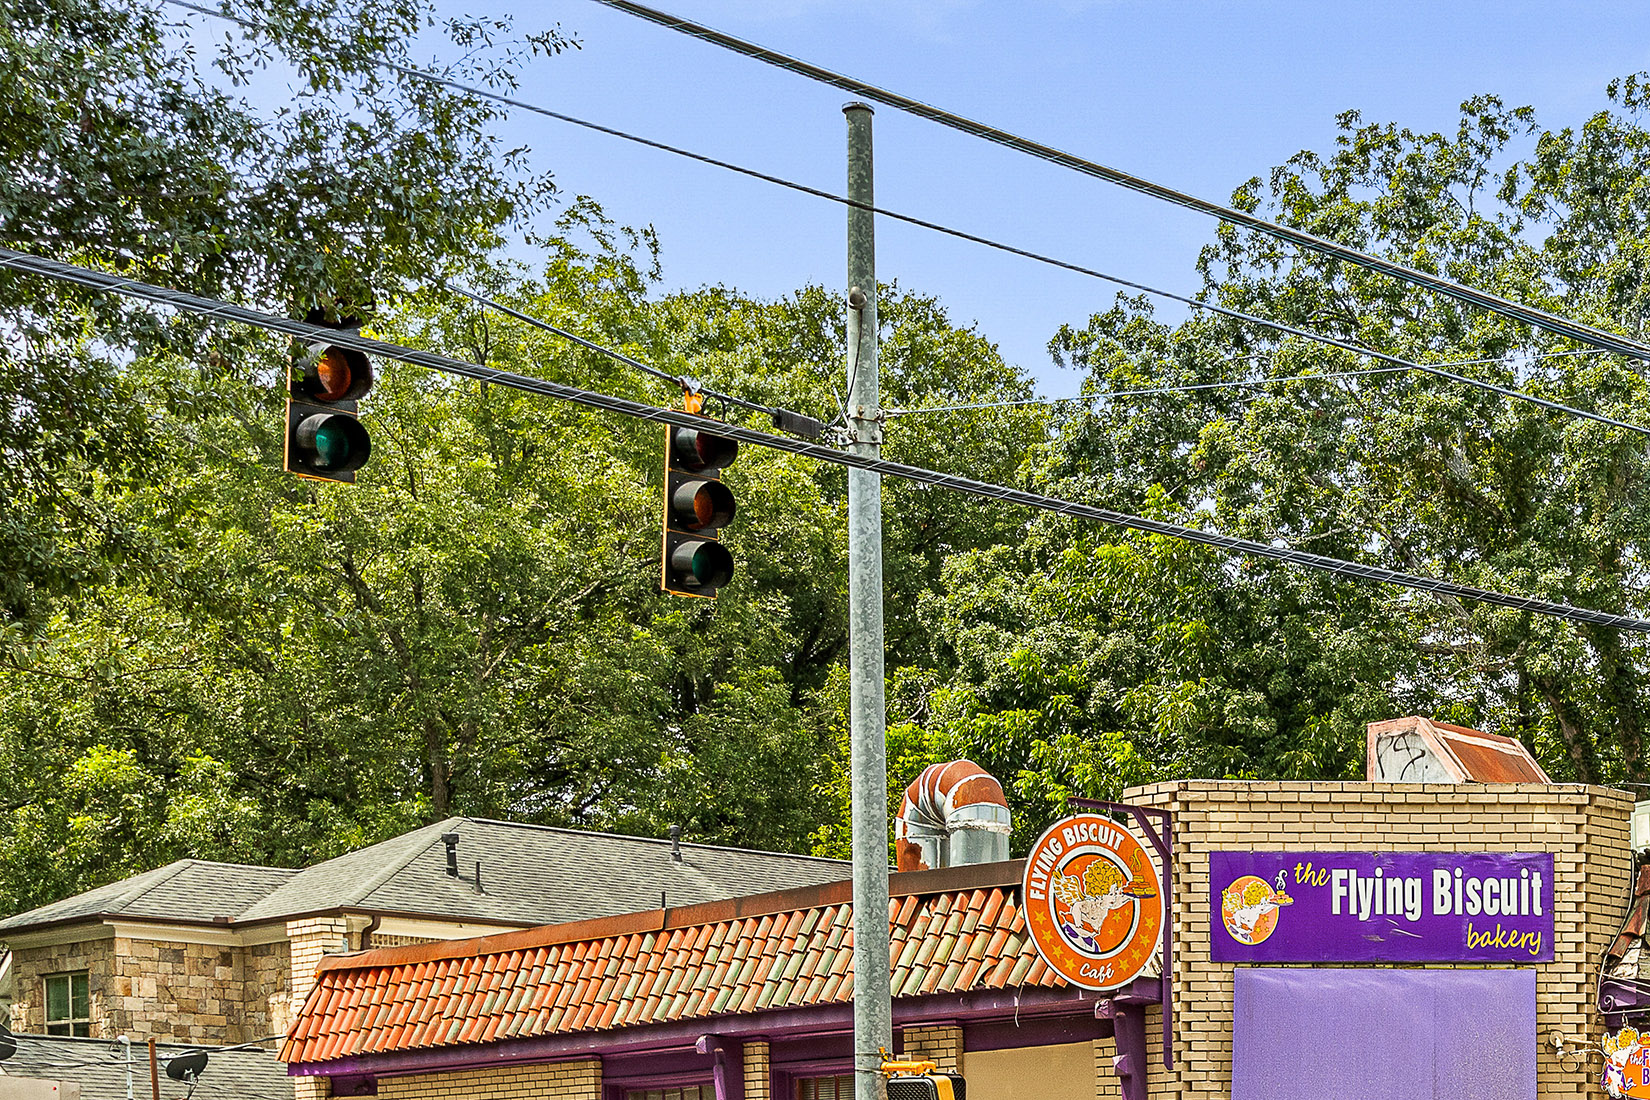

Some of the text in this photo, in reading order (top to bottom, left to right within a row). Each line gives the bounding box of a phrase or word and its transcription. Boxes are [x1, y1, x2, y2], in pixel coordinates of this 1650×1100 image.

[1030, 822, 1125, 900] FLYING BISCUIT
[1294, 862, 1543, 921] the Flying Biscuit
[1467, 923, 1542, 956] bakery
